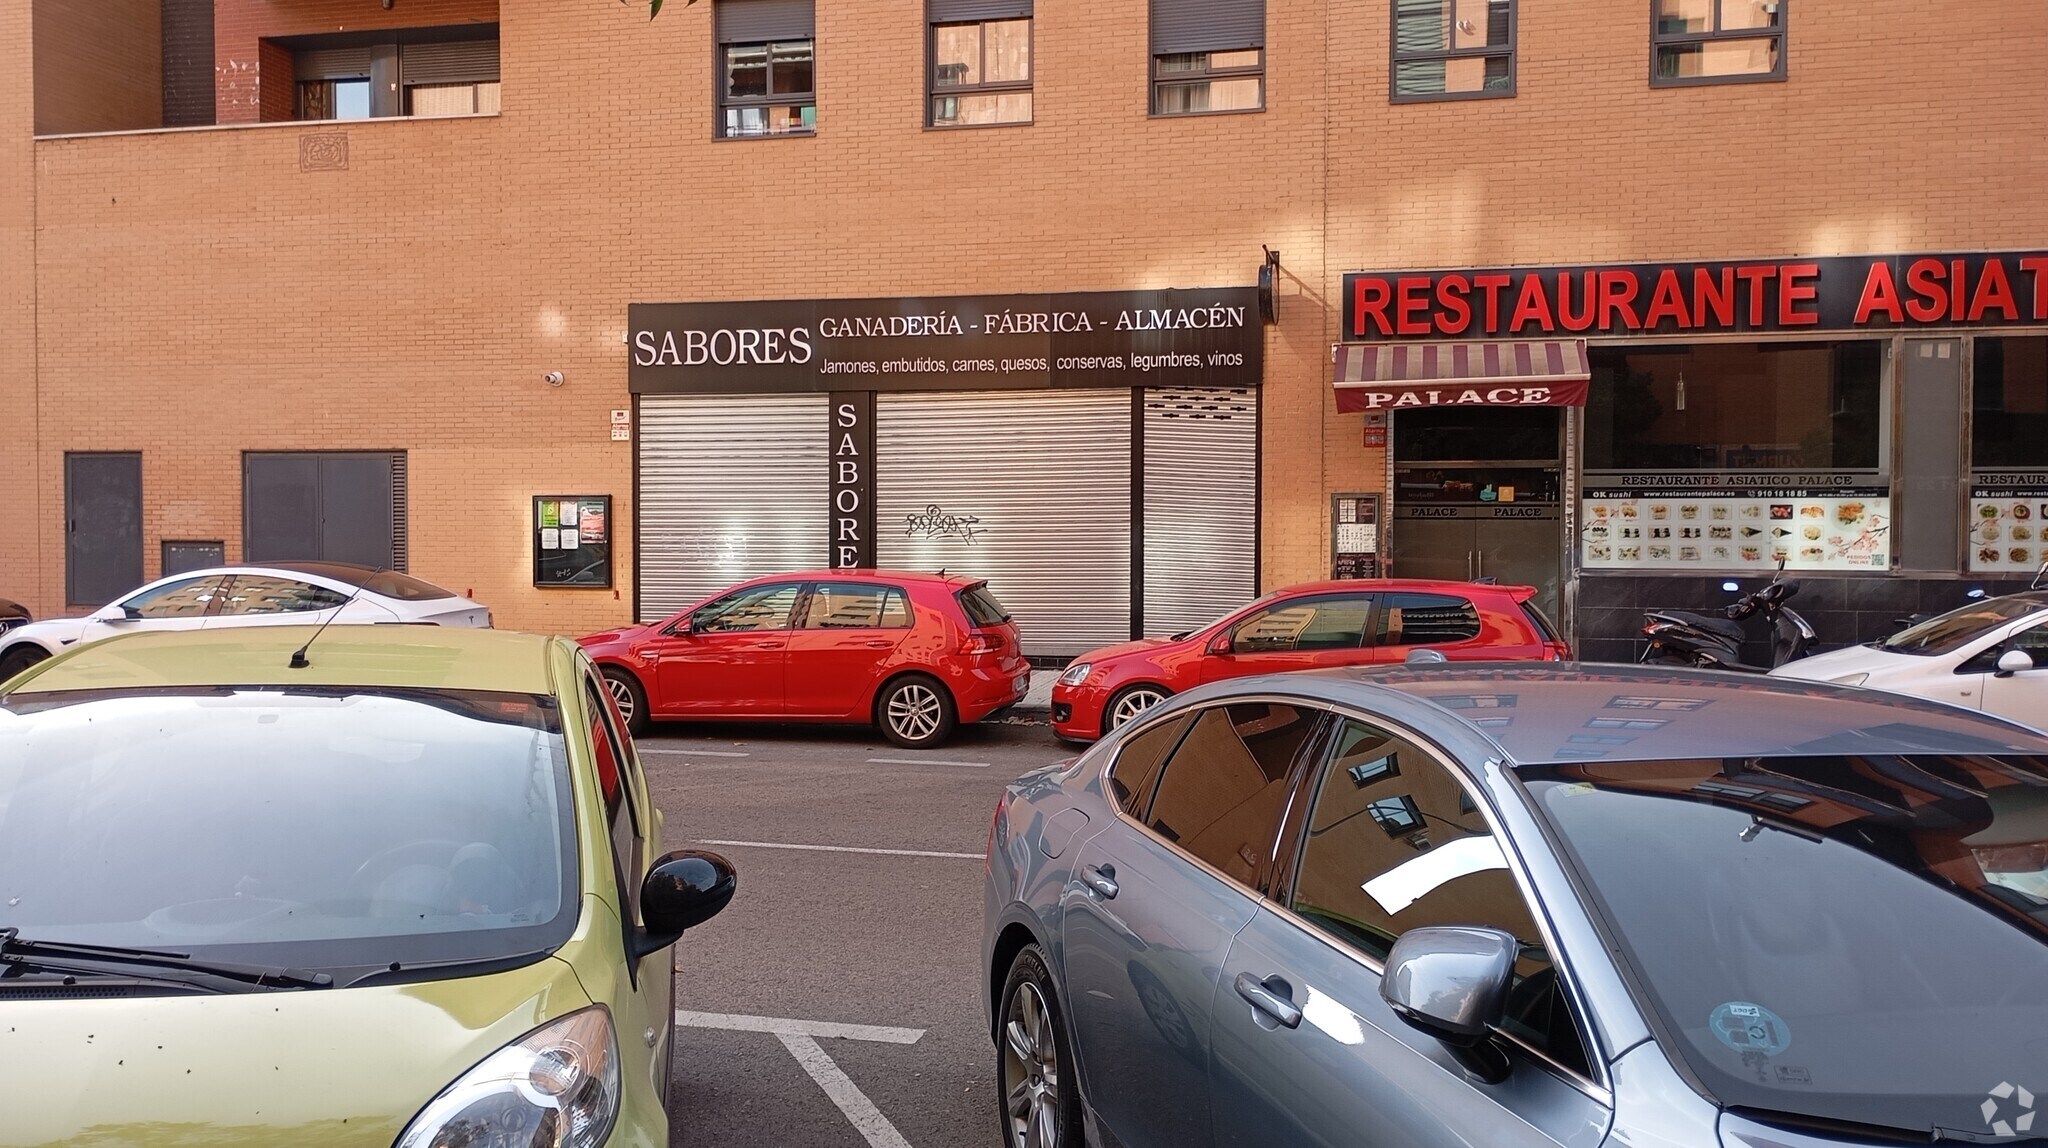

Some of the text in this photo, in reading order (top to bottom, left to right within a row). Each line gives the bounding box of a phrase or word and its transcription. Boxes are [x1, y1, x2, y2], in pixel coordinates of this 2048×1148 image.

[1354, 257, 2048, 336] RESTAURANTE ASIAT
[820, 311, 963, 338] GANADERÍA
[984, 309, 1093, 334] FÁBRICA
[1114, 303, 1245, 330] ALMACÉN
[634, 328, 812, 366] SABORES
[820, 350, 1243, 375] Jamones, embutidos, carnes, quesos, conservas, legumbres, vinos
[1365, 387, 1552, 409] PALACE
[1622, 476, 1853, 486] RESTAURANTE ASIATICO PALACE
[1979, 475, 2048, 484] RESTAUR
[1608, 490, 1632, 498] sushi
[1643, 490, 1735, 498] www.restaurantepalace.es
[1411, 508, 1457, 517] PALACE
[1493, 508, 1542, 517] PALACE
